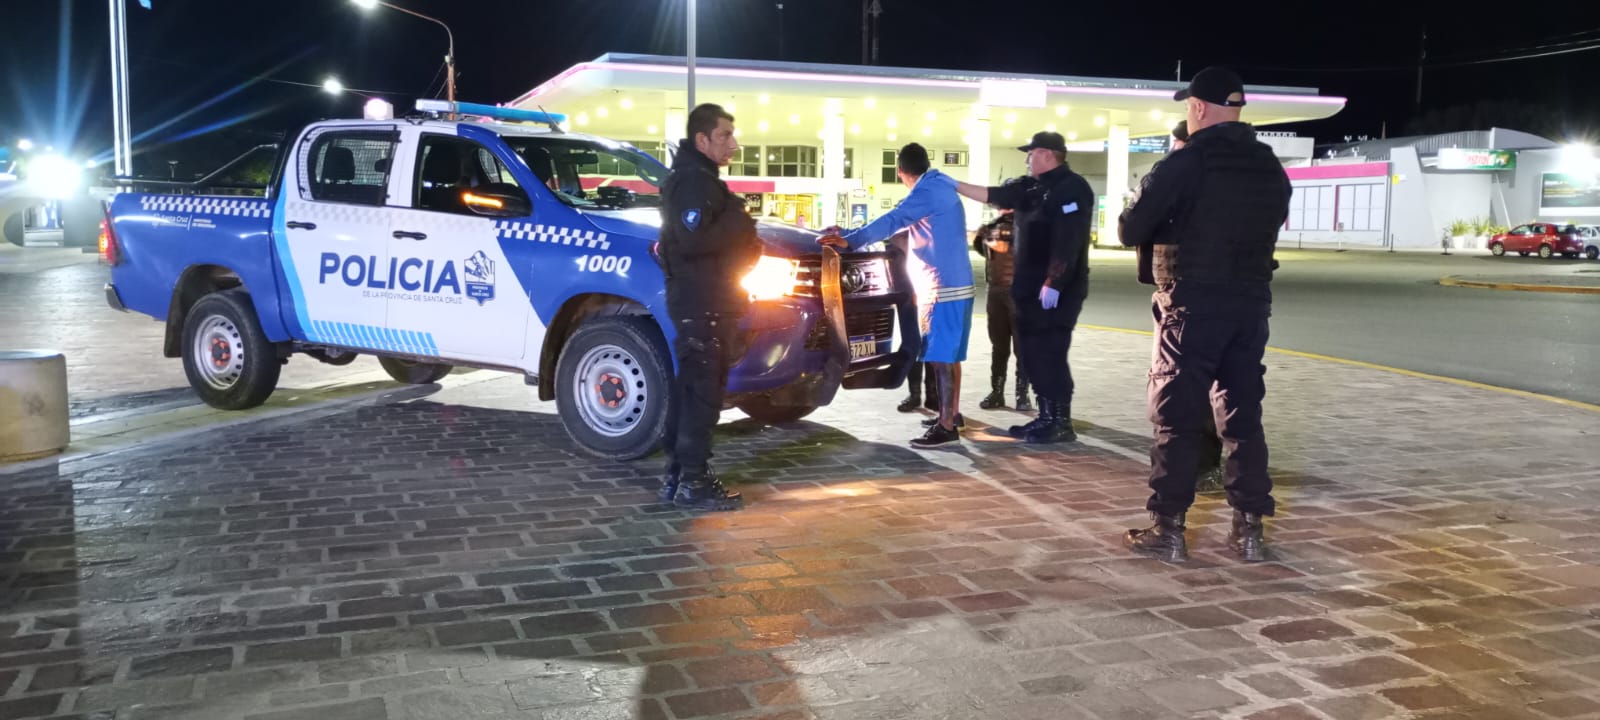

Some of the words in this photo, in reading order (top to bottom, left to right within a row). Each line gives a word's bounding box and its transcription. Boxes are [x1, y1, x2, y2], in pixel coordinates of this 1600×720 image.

[319, 252, 461, 294] POLICIA
[575, 255, 632, 273] 1000
[362, 290, 370, 298] DE
[381, 291, 412, 300] PROVINCIA
[413, 294, 421, 302] DE
[423, 295, 443, 303] SANTA
